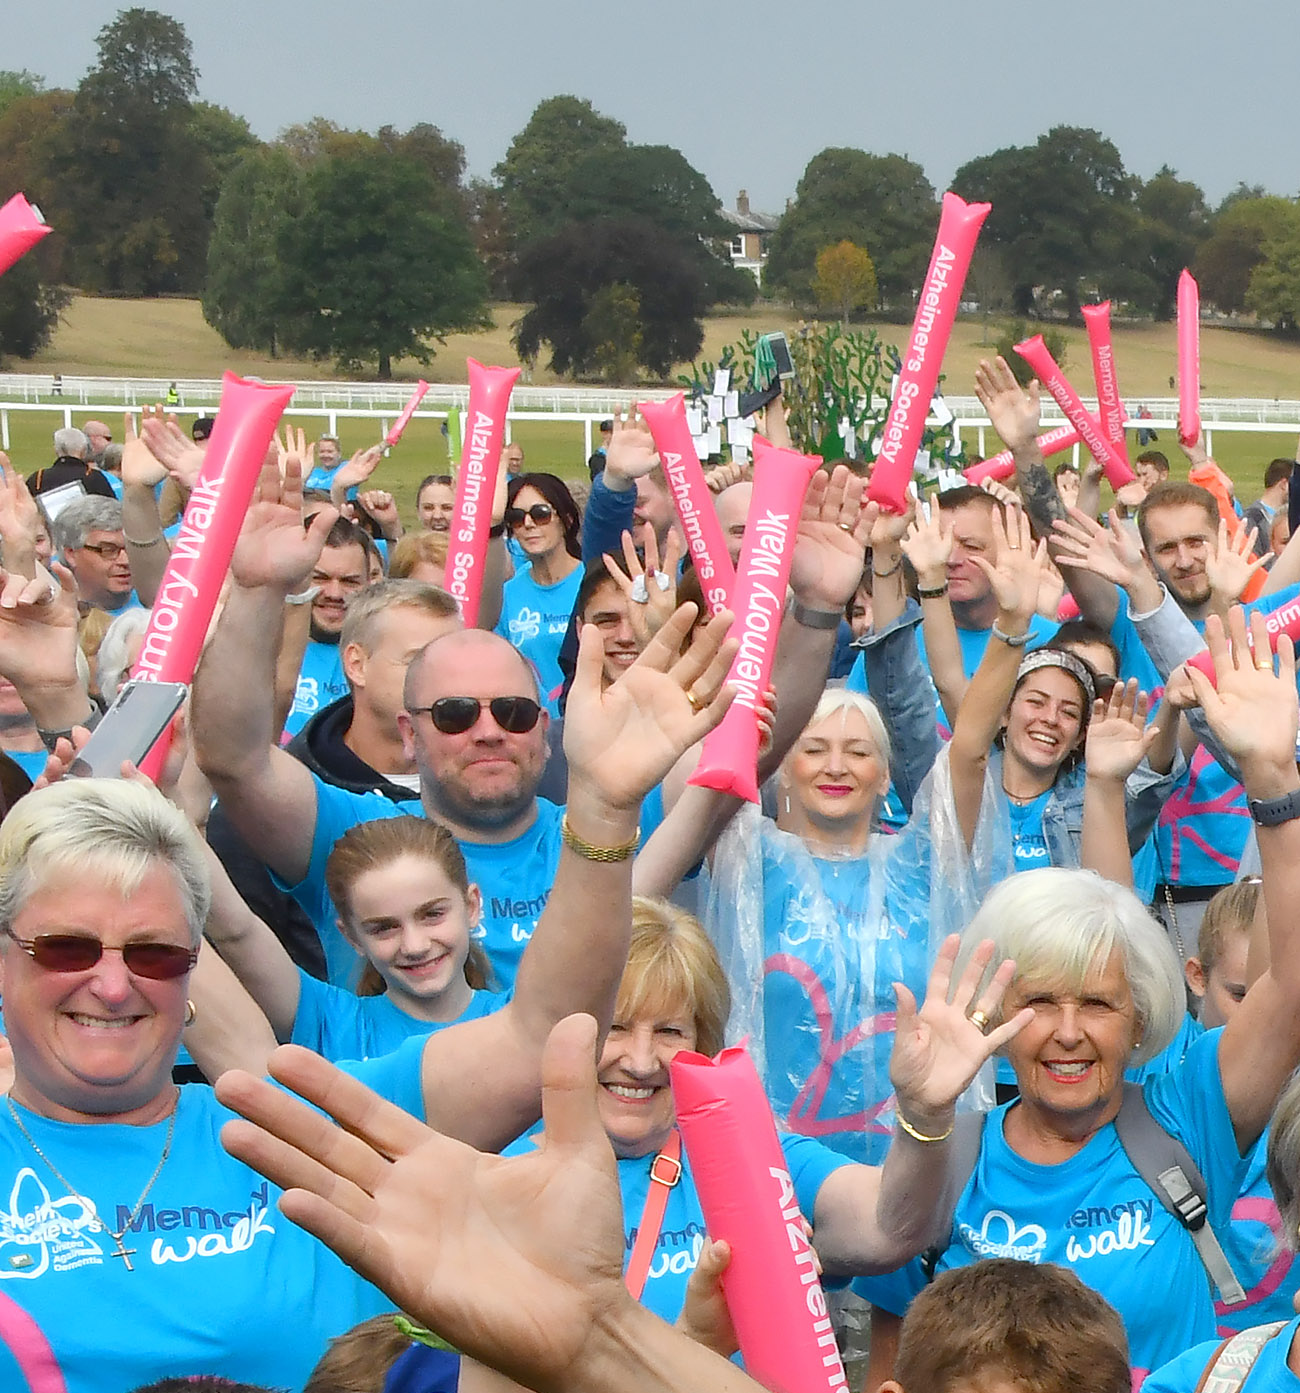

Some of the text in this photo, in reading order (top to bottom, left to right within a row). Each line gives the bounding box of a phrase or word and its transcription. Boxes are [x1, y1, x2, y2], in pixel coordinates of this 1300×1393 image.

[881, 244, 955, 463] Alzheimer's Society
[458, 411, 494, 544] Alzheimer's
[663, 451, 715, 580] Alzheimer's
[171, 475, 225, 560] Walk
[747, 509, 790, 578] Walk
[151, 1203, 275, 1265] walk
[1065, 1199, 1155, 1229] emory
[1066, 1210, 1155, 1262] walk
